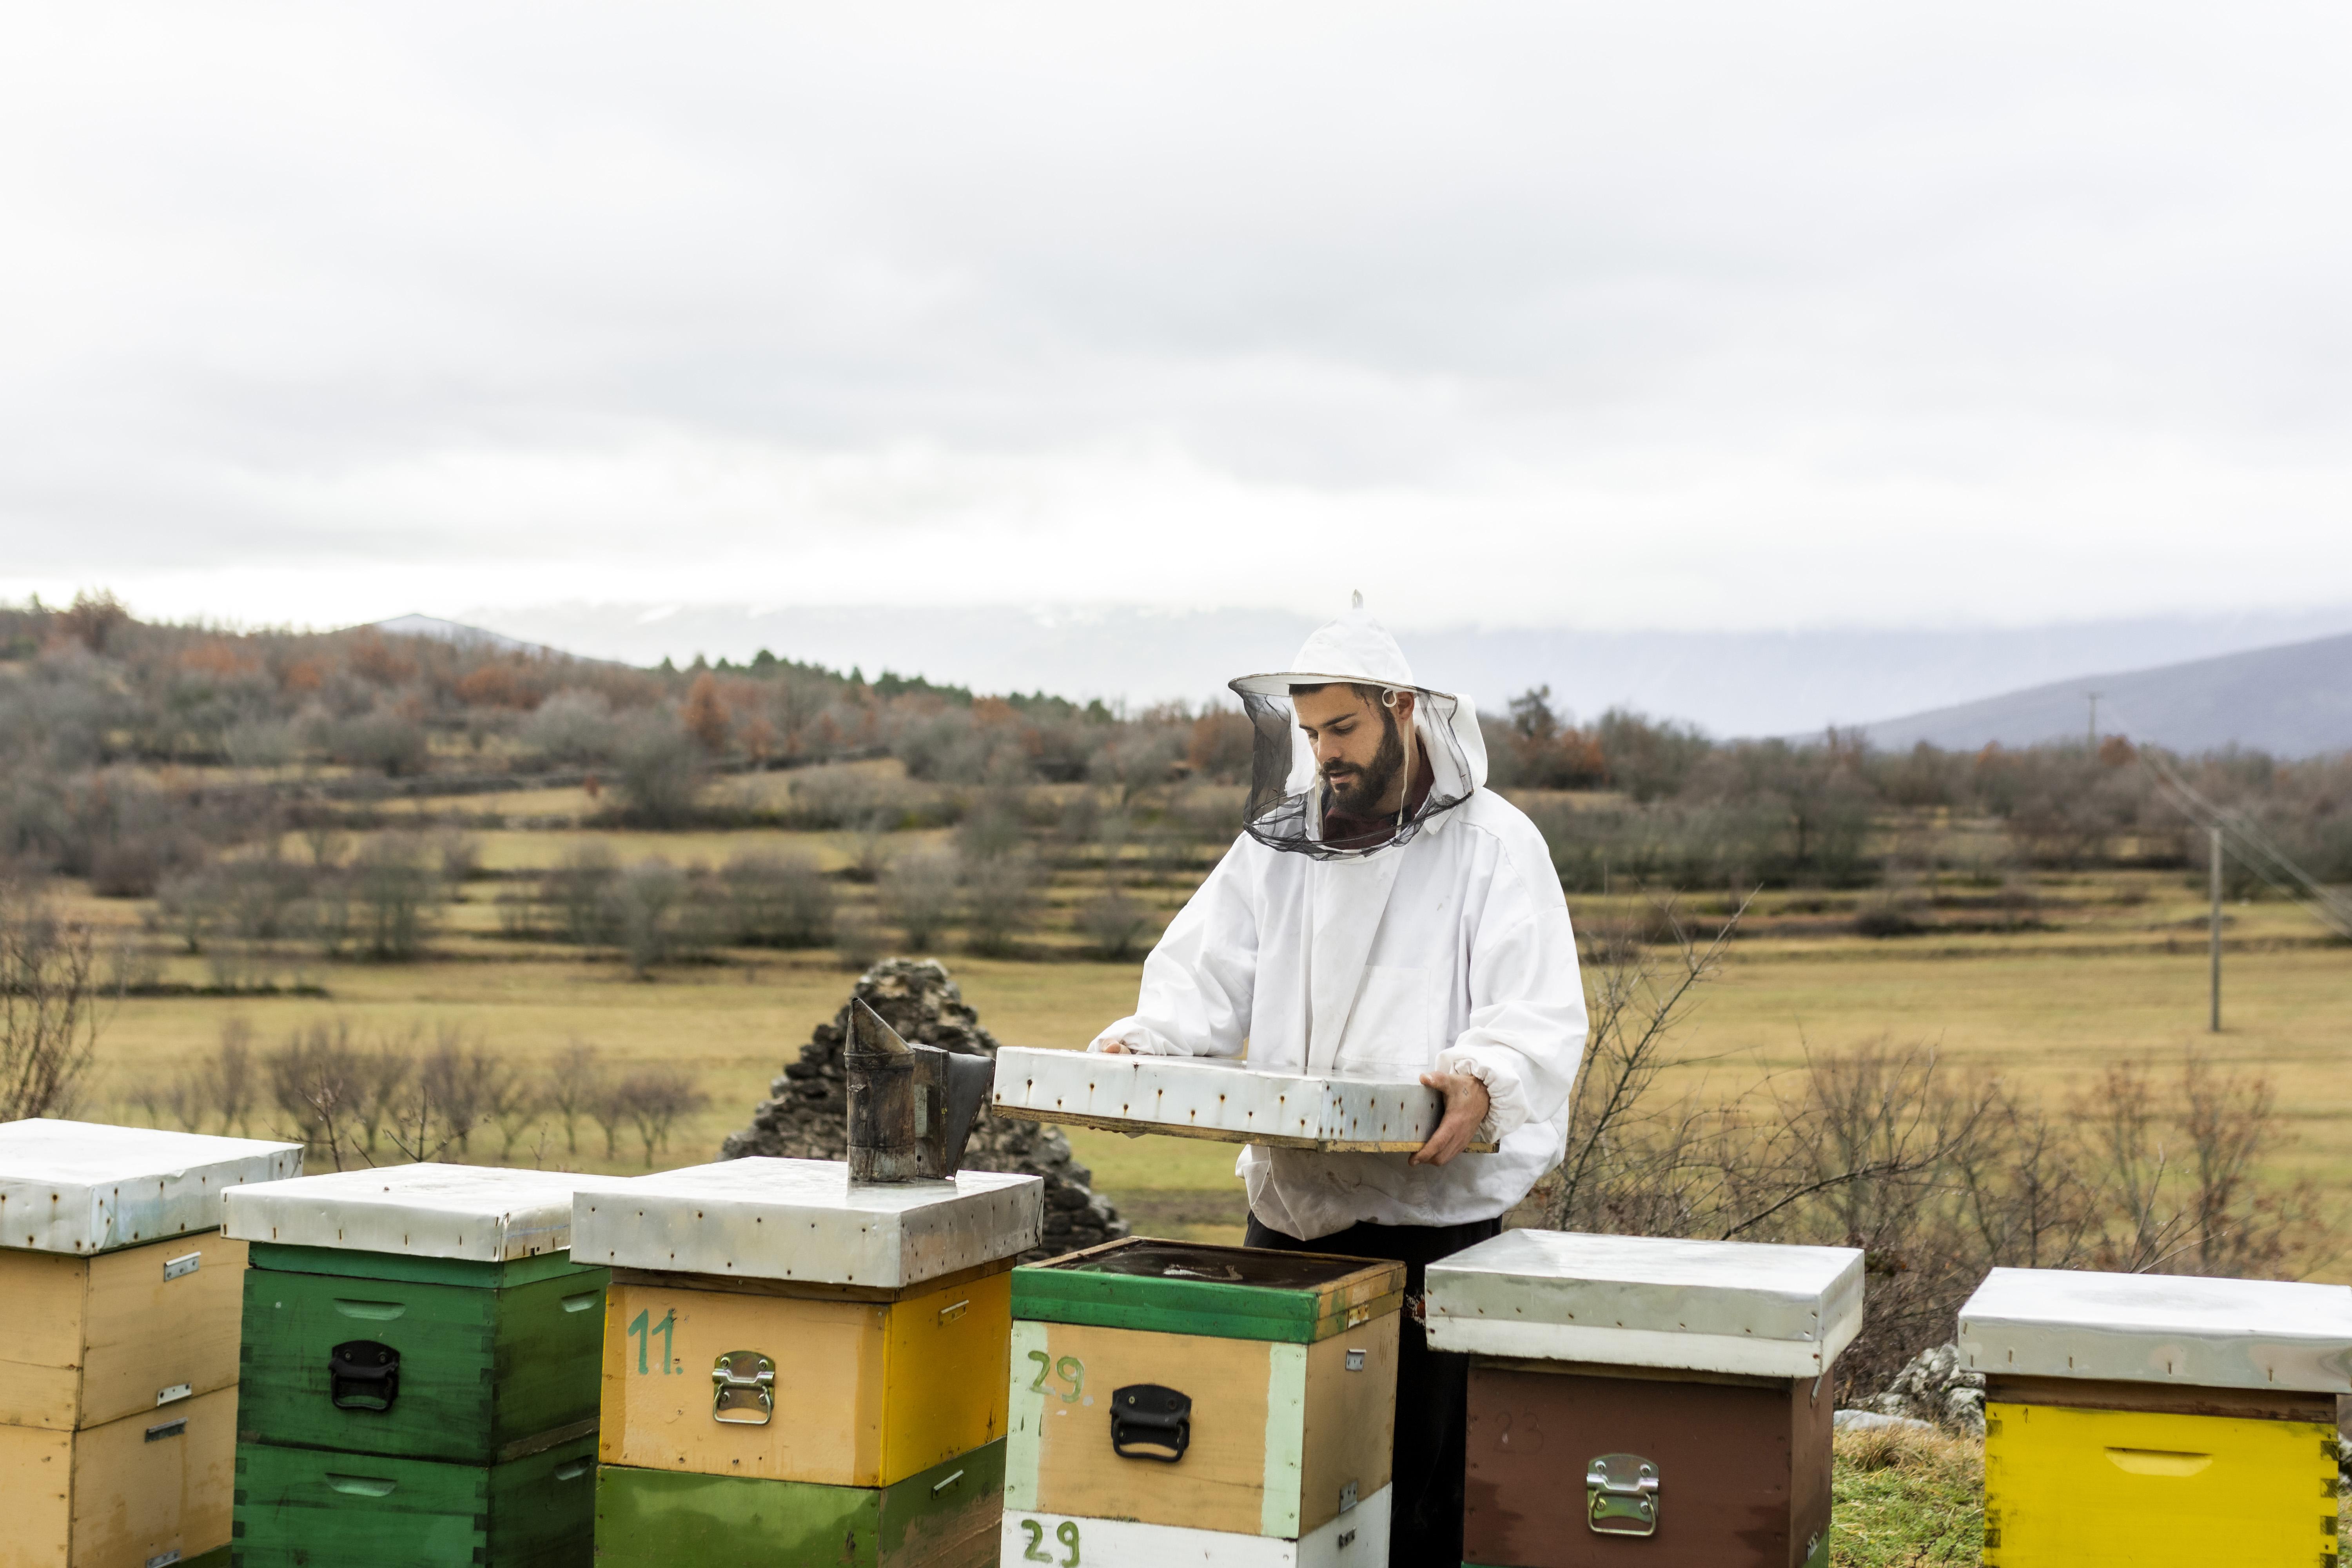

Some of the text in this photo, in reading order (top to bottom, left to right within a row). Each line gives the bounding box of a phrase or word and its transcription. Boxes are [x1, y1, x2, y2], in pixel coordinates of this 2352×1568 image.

[628, 1308, 683, 1375] 11.
[1028, 1350, 1084, 1403] 29
[1021, 1519, 1080, 1568] 29
